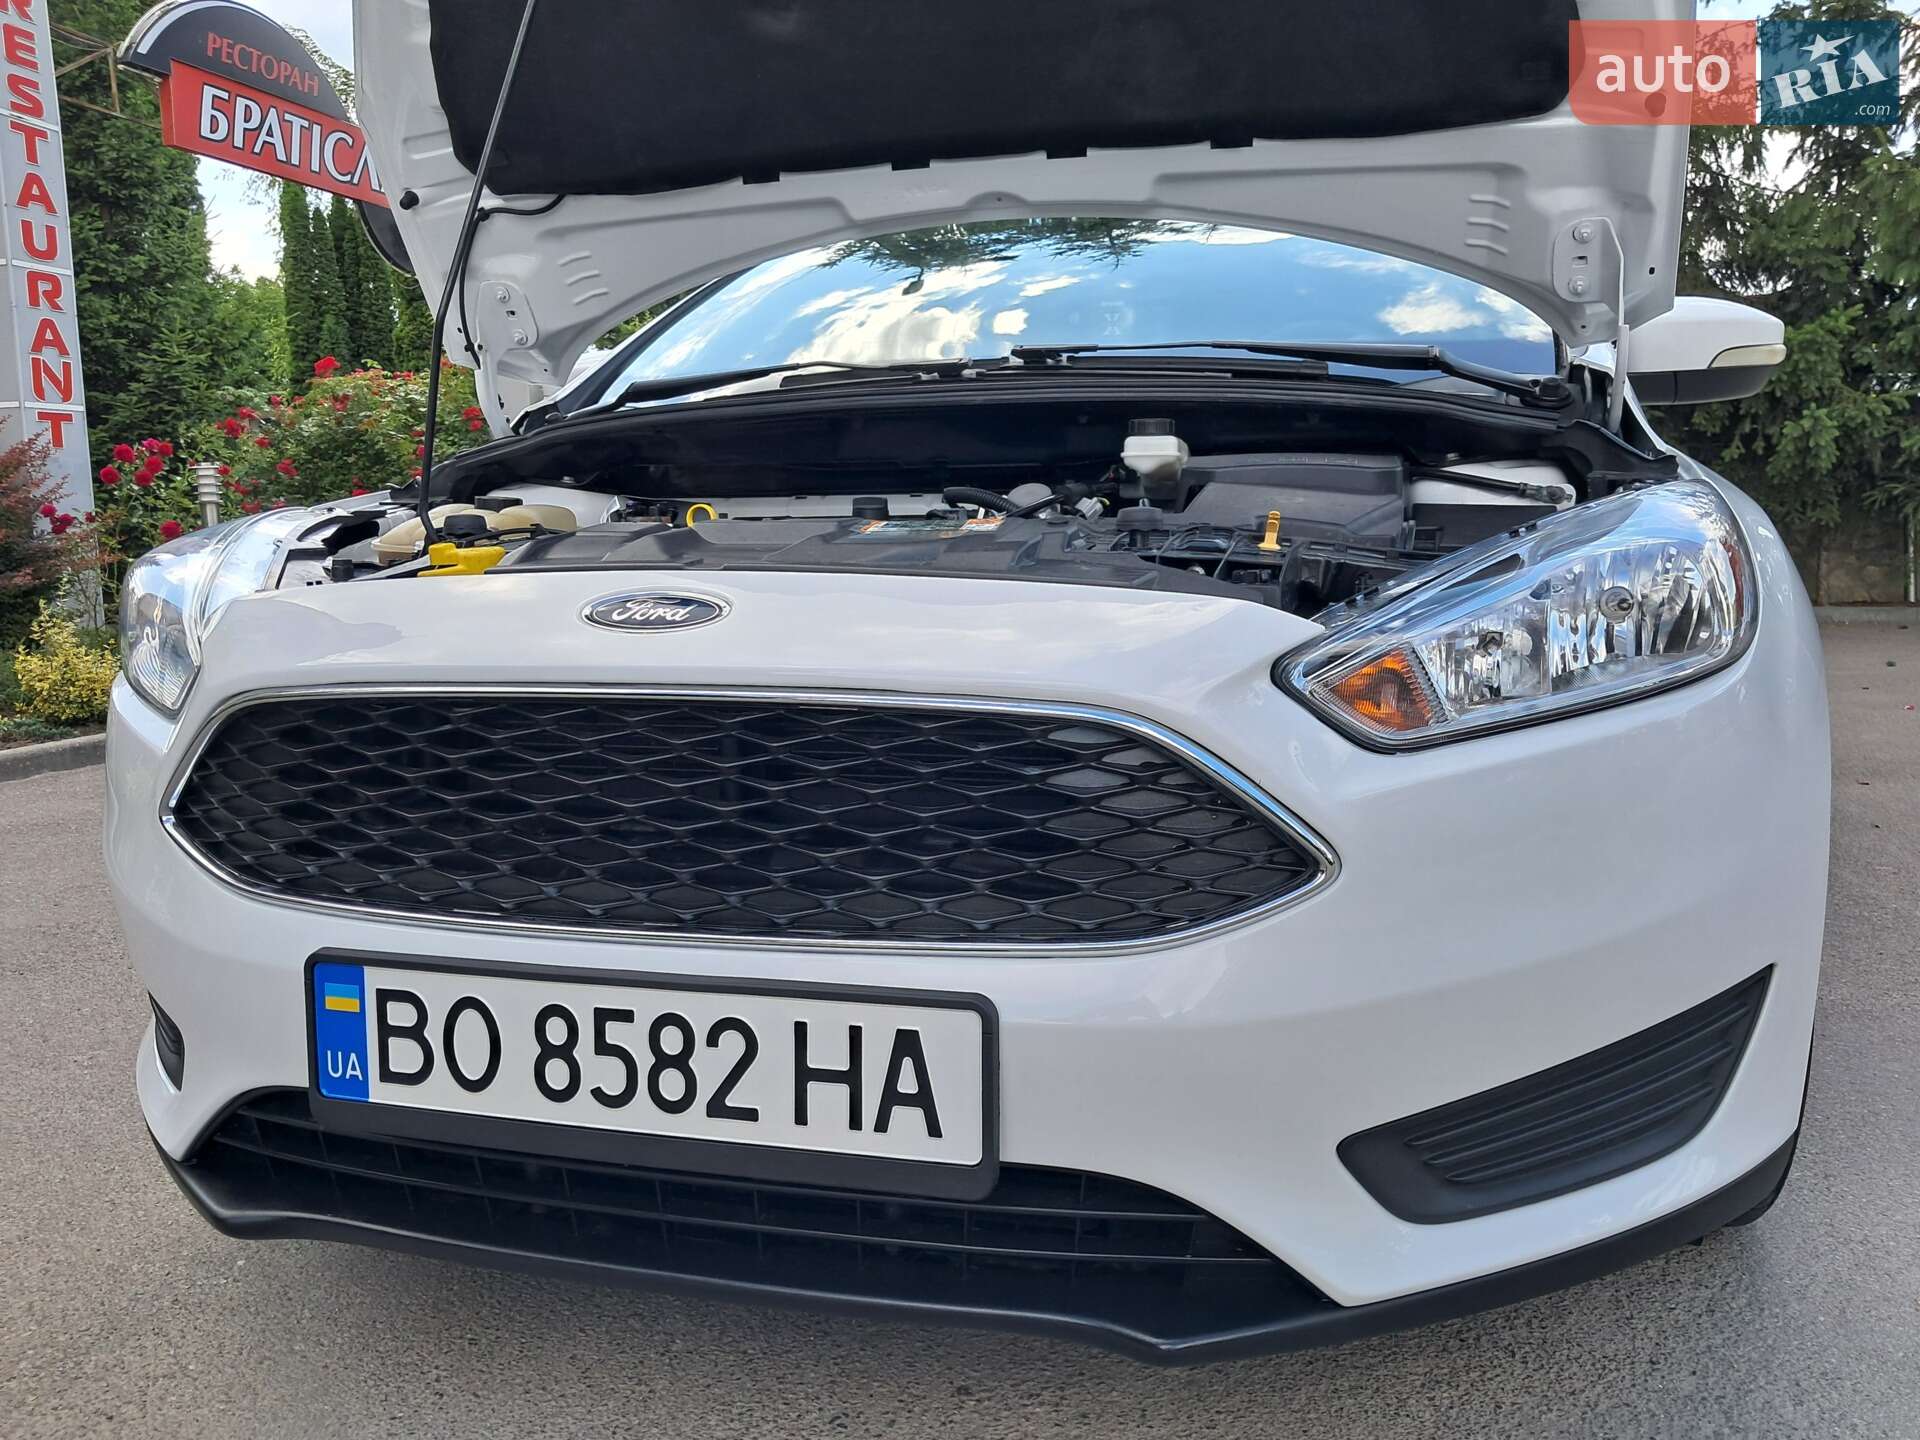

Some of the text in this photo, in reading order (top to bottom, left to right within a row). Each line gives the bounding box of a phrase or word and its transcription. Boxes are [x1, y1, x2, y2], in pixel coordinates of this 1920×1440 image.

[207, 32, 319, 97] РЕСТОРАН
[199, 83, 385, 193] БРАТІСЛ
[611, 599, 699, 621] Ford
[326, 1050, 364, 1082] UA
[375, 988, 943, 1139] BO 8582 HA
